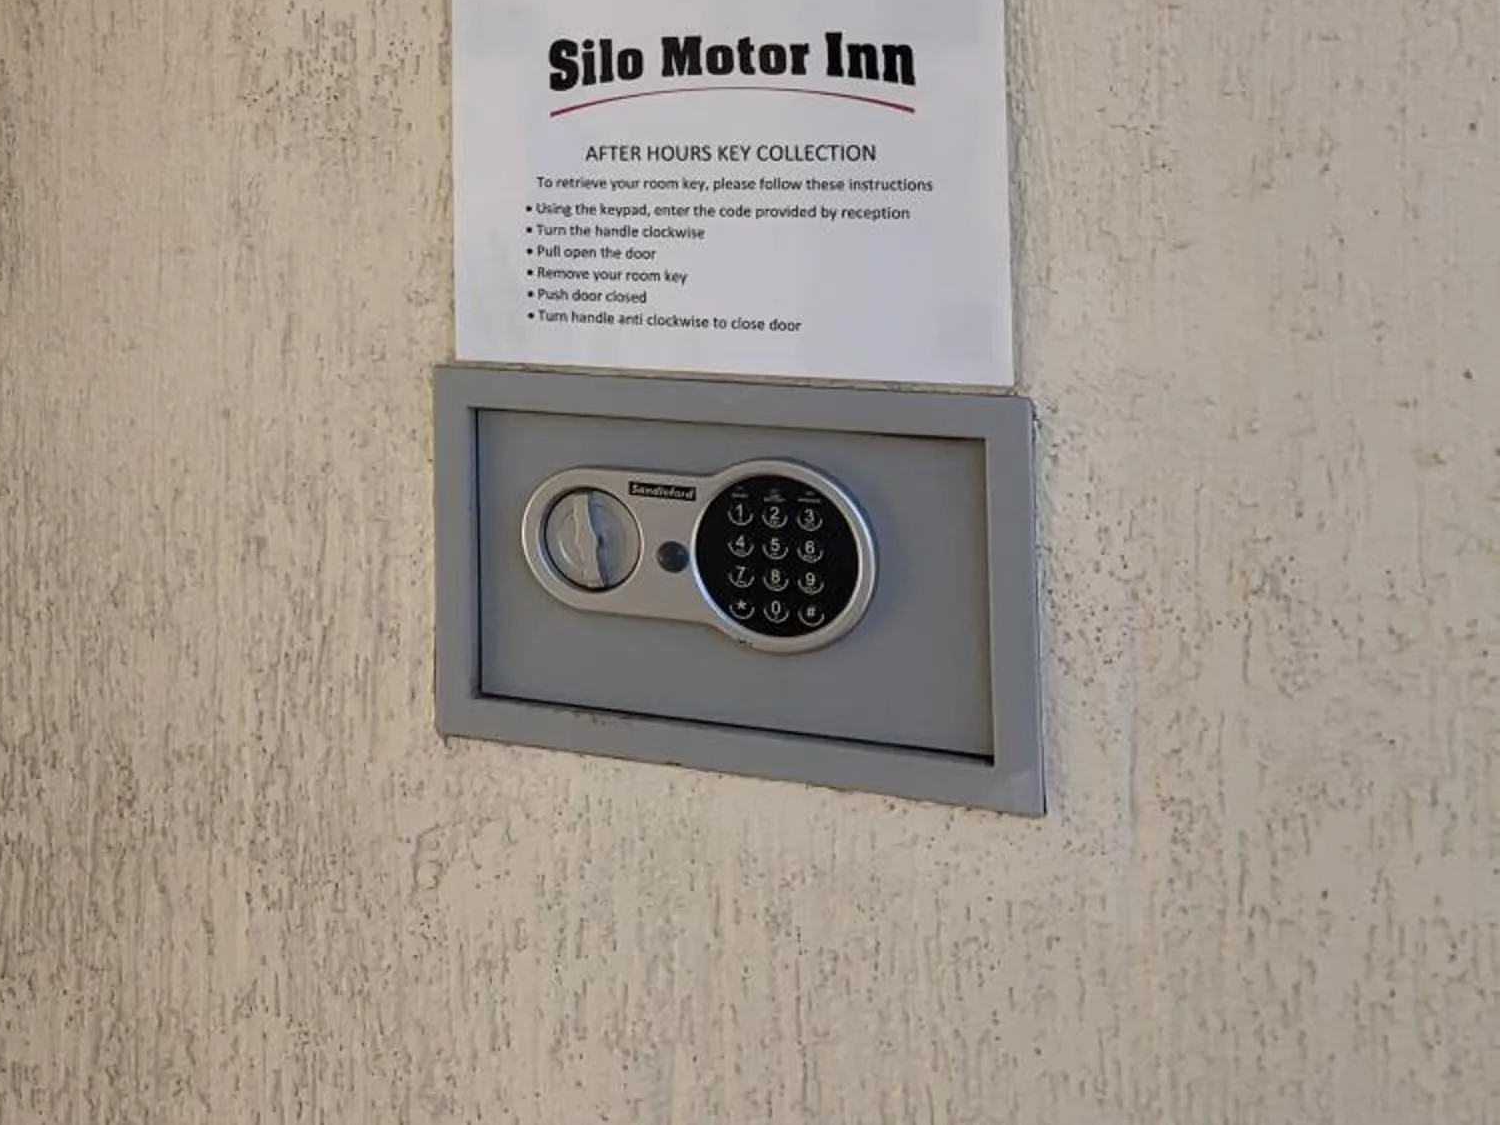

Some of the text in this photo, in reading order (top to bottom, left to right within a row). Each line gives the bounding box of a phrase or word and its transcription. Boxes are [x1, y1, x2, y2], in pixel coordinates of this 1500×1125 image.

[549, 31, 916, 91] Silo Motor Inn
[585, 144, 876, 163] AFTER HOURS KEY COLLECTION
[536, 176, 933, 193] To retrieve your room key, please follow these instructions
[536, 202, 911, 222] Using the keypad, enter the code provided by reception
[536, 224, 705, 239] Turn the handle clockwise
[537, 245, 657, 260] Pull open the door
[537, 266, 688, 286] Remove your room key
[537, 288, 647, 304] Push door closed
[538, 309, 802, 332] Turn handle anti clockwise to close door
[735, 503, 815, 523] 1 2 3
[735, 535, 815, 554] 4 5 6
[736, 565, 815, 586] 7 8 9
